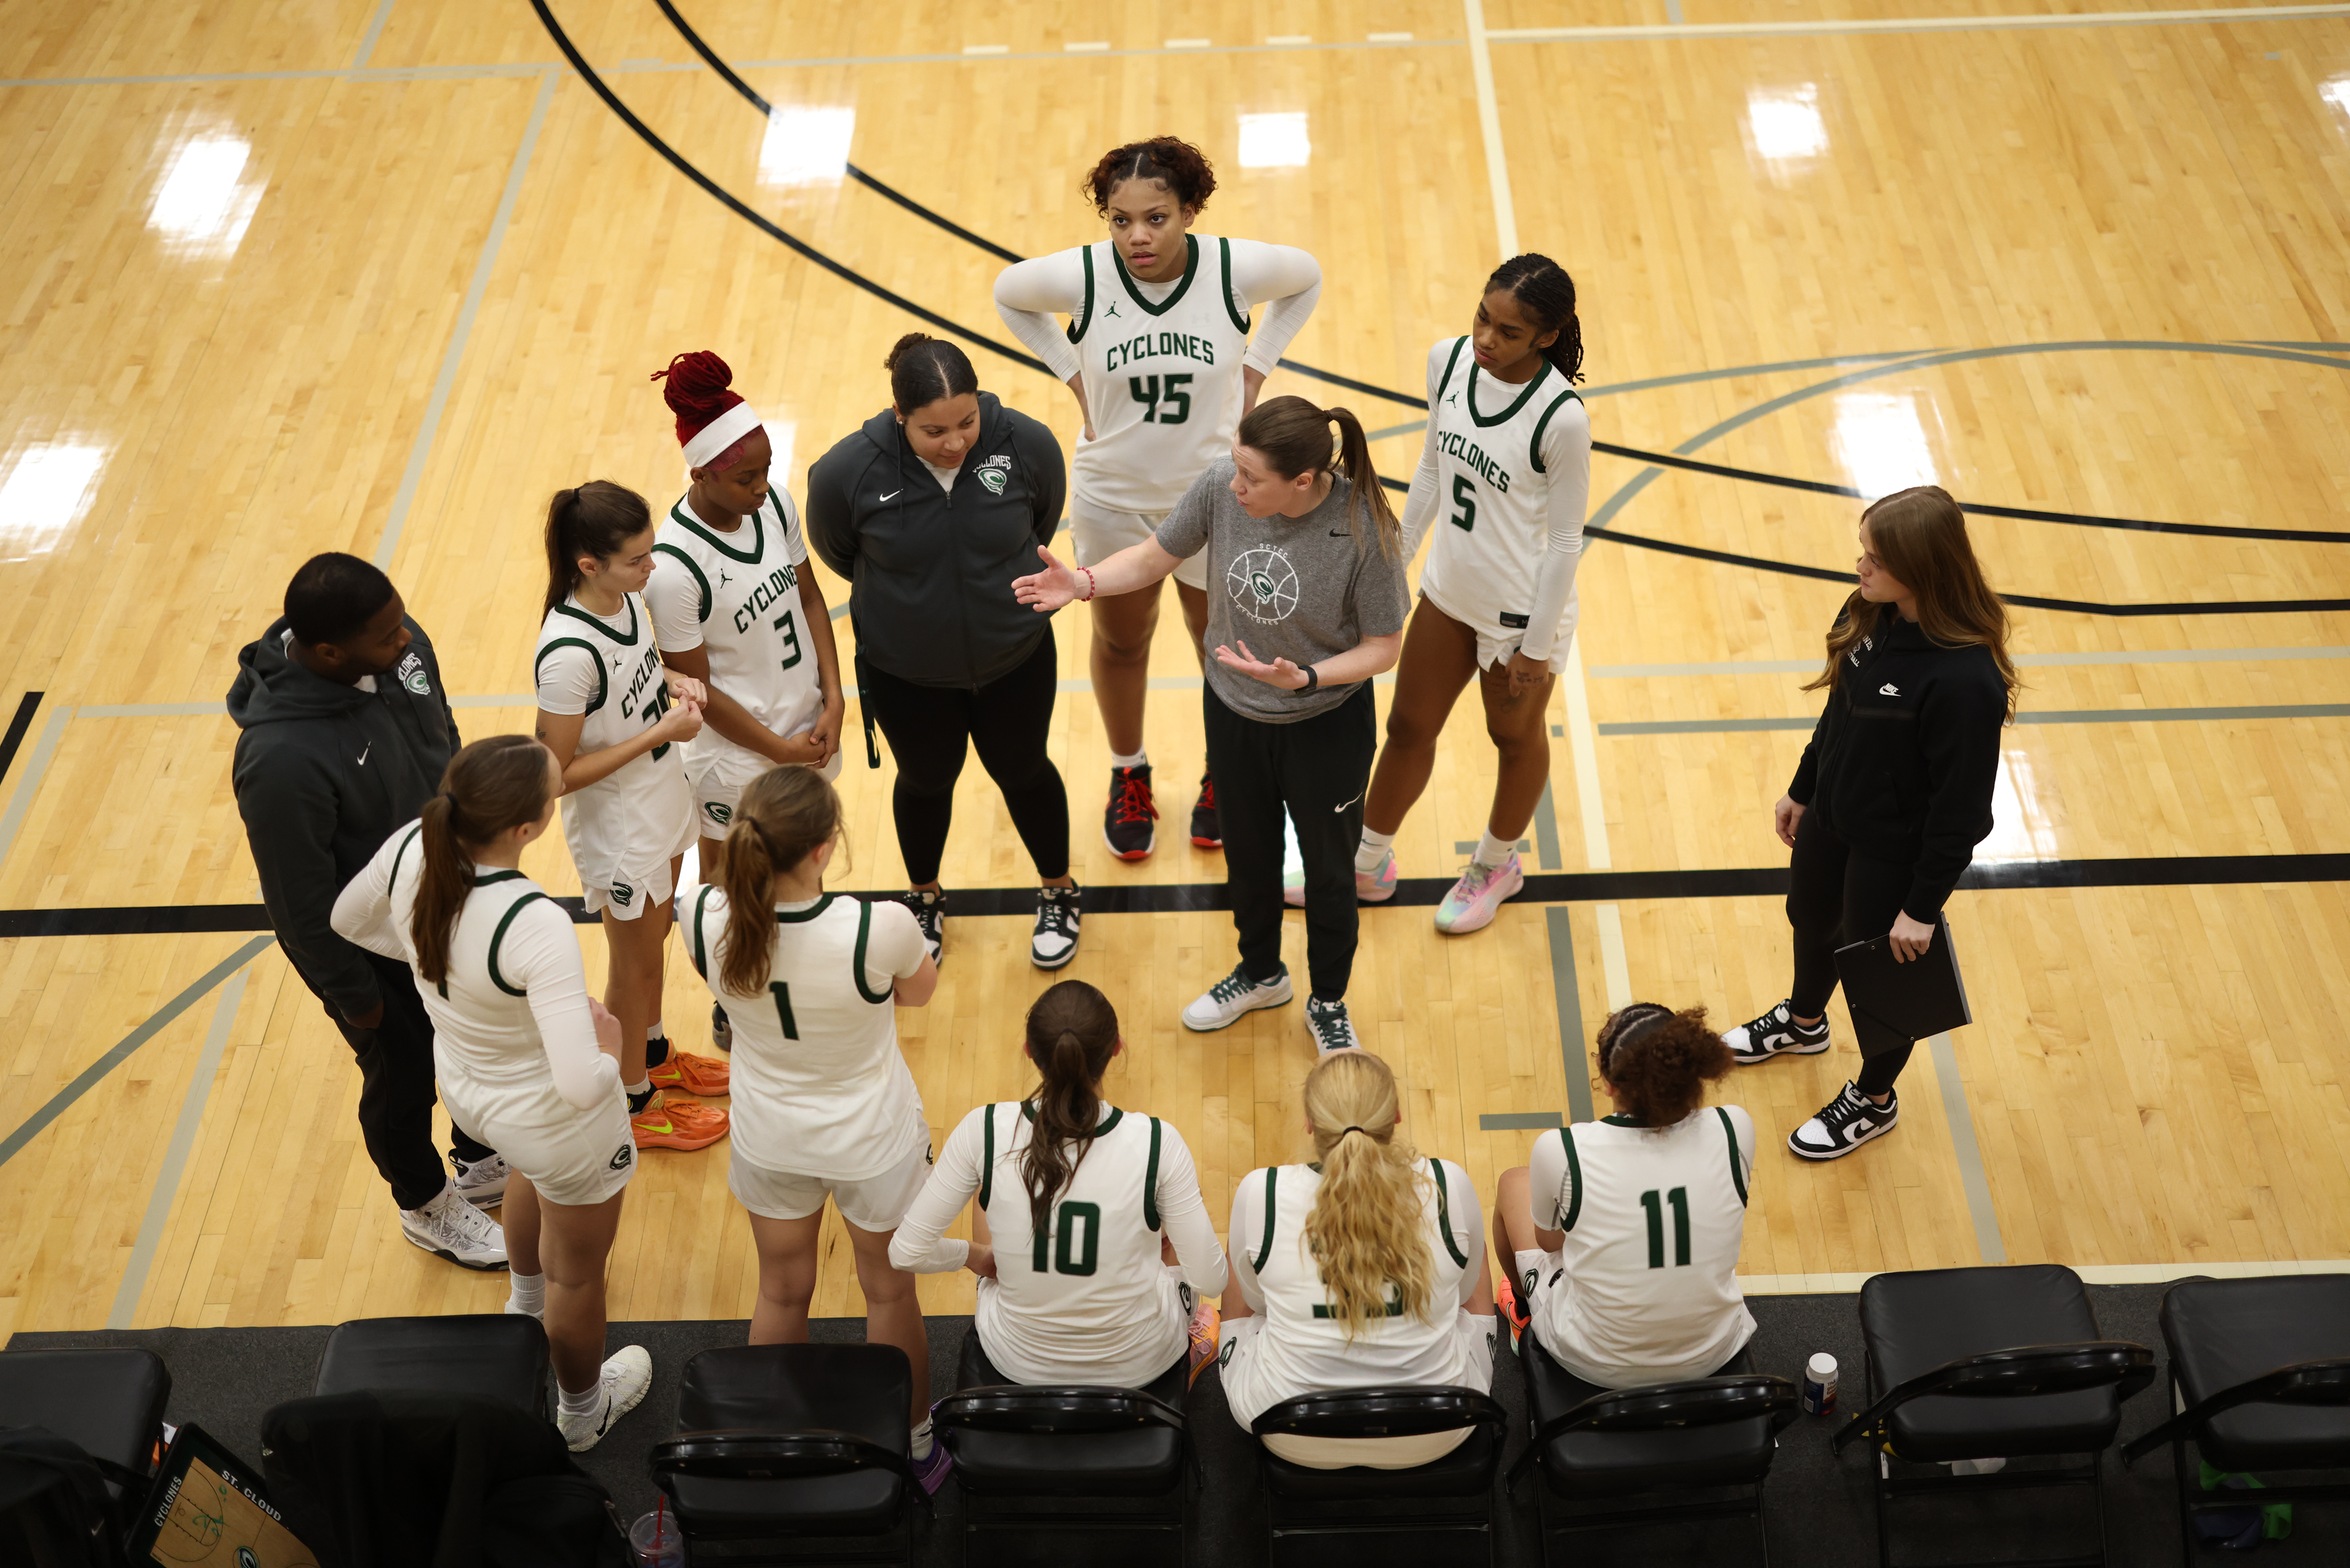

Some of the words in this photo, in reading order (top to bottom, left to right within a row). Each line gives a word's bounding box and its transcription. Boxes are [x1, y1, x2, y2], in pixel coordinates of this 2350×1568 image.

[1107, 332, 1214, 372] CYCLONES
[1128, 373, 1194, 425] 45
[972, 454, 1012, 473] LONES
[1452, 473, 1476, 532] 5
[734, 564, 798, 634] CYCLONE
[773, 608, 802, 671] 3
[621, 641, 660, 720] CYCLON
[769, 980, 800, 1041] 1
[1032, 1201, 1101, 1277] 10
[1640, 1186, 1691, 1270] 11
[154, 1476, 182, 1527] CYCLONES
[221, 1470, 240, 1489] ST.
[243, 1487, 282, 1522] CLOUD
